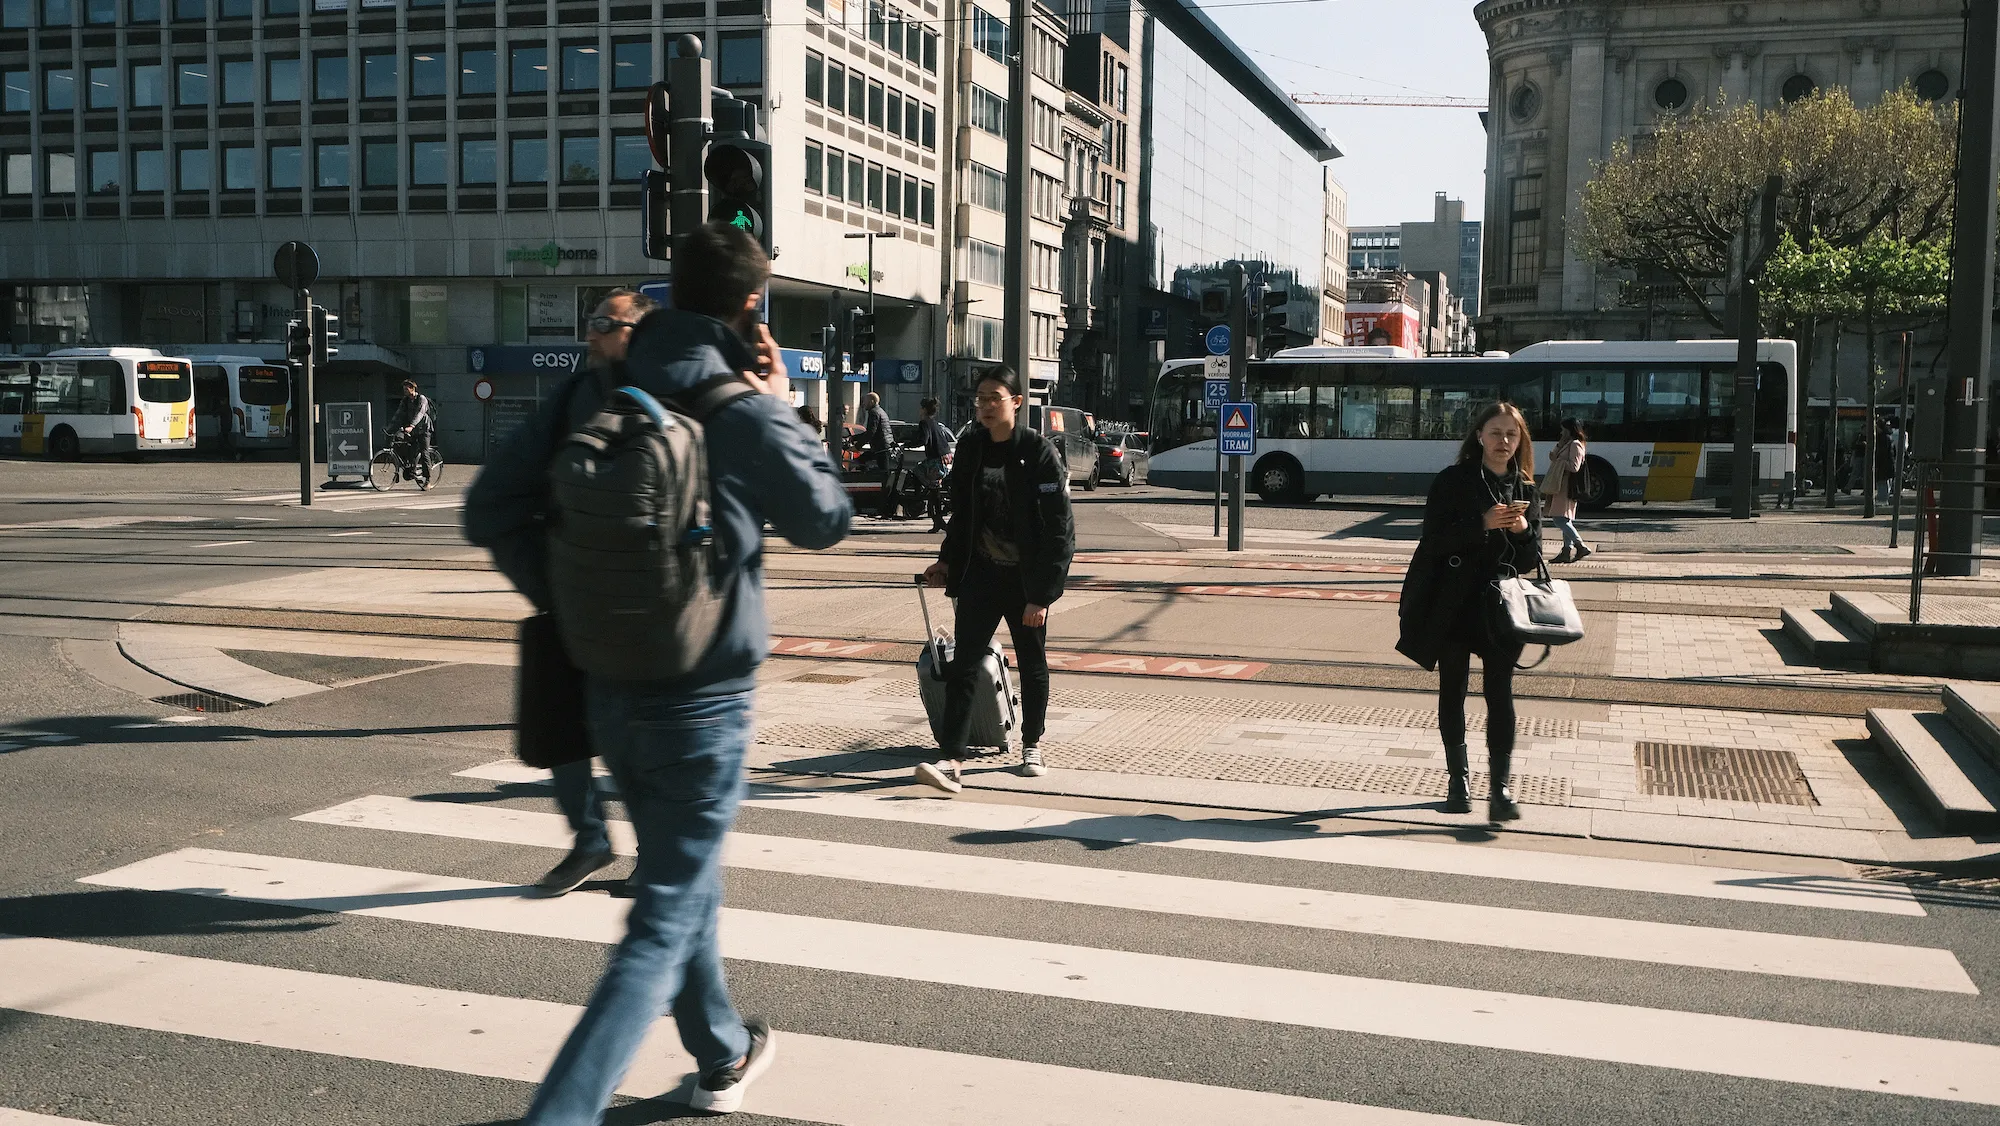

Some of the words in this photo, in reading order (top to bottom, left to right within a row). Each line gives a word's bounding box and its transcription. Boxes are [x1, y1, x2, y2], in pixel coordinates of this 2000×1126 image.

[532, 352, 581, 374] easy
[802, 356, 824, 378] easy
[1209, 383, 1227, 397] 25
[343, 411, 352, 425] P
[1224, 440, 1250, 451] TRAM
